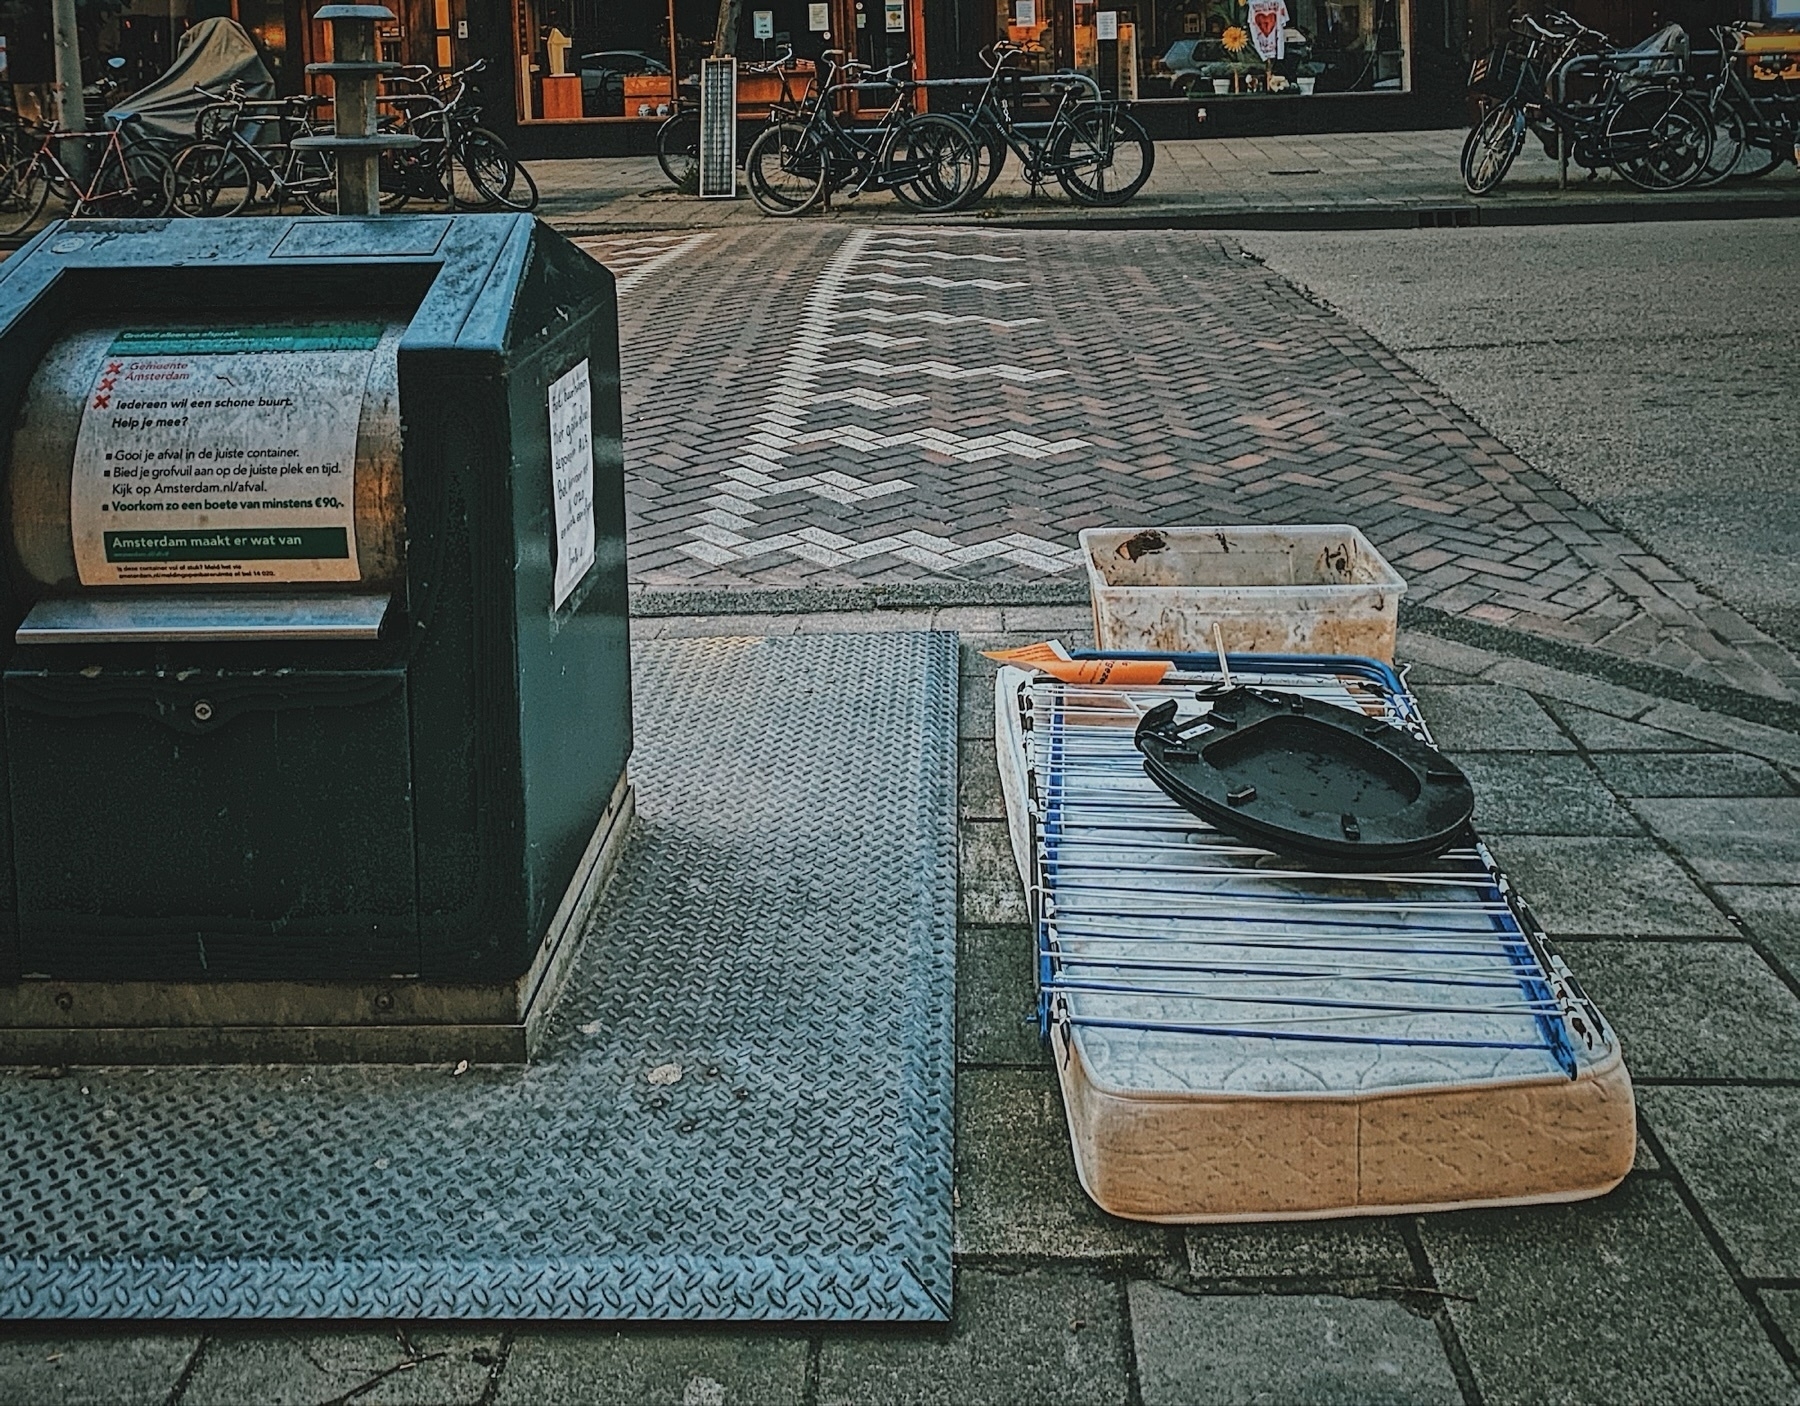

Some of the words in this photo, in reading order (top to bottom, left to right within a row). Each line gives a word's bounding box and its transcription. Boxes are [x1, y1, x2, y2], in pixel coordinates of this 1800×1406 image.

[201, 330, 240, 338] afspraak
[130, 362, 188, 371] Gemeente
[125, 371, 190, 381] Amsterdam
[116, 400, 168, 410] Iedereen
[170, 399, 189, 409] wil
[190, 400, 212, 409] een
[214, 398, 255, 408] schone
[257, 397, 293, 407] buurt.
[111, 418, 140, 430] Help
[141, 418, 153, 430] je
[155, 416, 189, 428] mee?
[114, 450, 143, 461] Gooi
[143, 450, 155, 463] je
[157, 449, 183, 460] afval
[185, 450, 196, 460] in
[197, 449, 213, 460] de
[214, 448, 245, 461] juiste
[246, 447, 300, 459] container.
[113, 466, 139, 478] Bied
[139, 467, 150, 480] je
[151, 465, 193, 481] grofvuil
[194, 467, 214, 477] aan
[215, 467, 231, 480] op
[232, 464, 248, 476] de
[248, 463, 278, 478] juiste
[279, 462, 304, 478] plek
[305, 465, 320, 475] en
[321, 462, 343, 478] tijd.
[112, 483, 133, 497] Kijk
[135, 485, 151, 498] op
[153, 481, 268, 494] Amsterdam.nl/afval.
[112, 500, 164, 512] Voorkom
[165, 502, 180, 512] zo
[181, 501, 203, 511] een
[204, 499, 238, 511] boete
[239, 500, 261, 510] van
[262, 498, 313, 510] minstens
[112, 536, 188, 549] Amsterdam
[190, 535, 231, 548] maakt
[233, 537, 248, 547] er
[249, 535, 276, 547] wat
[277, 535, 302, 546] van
